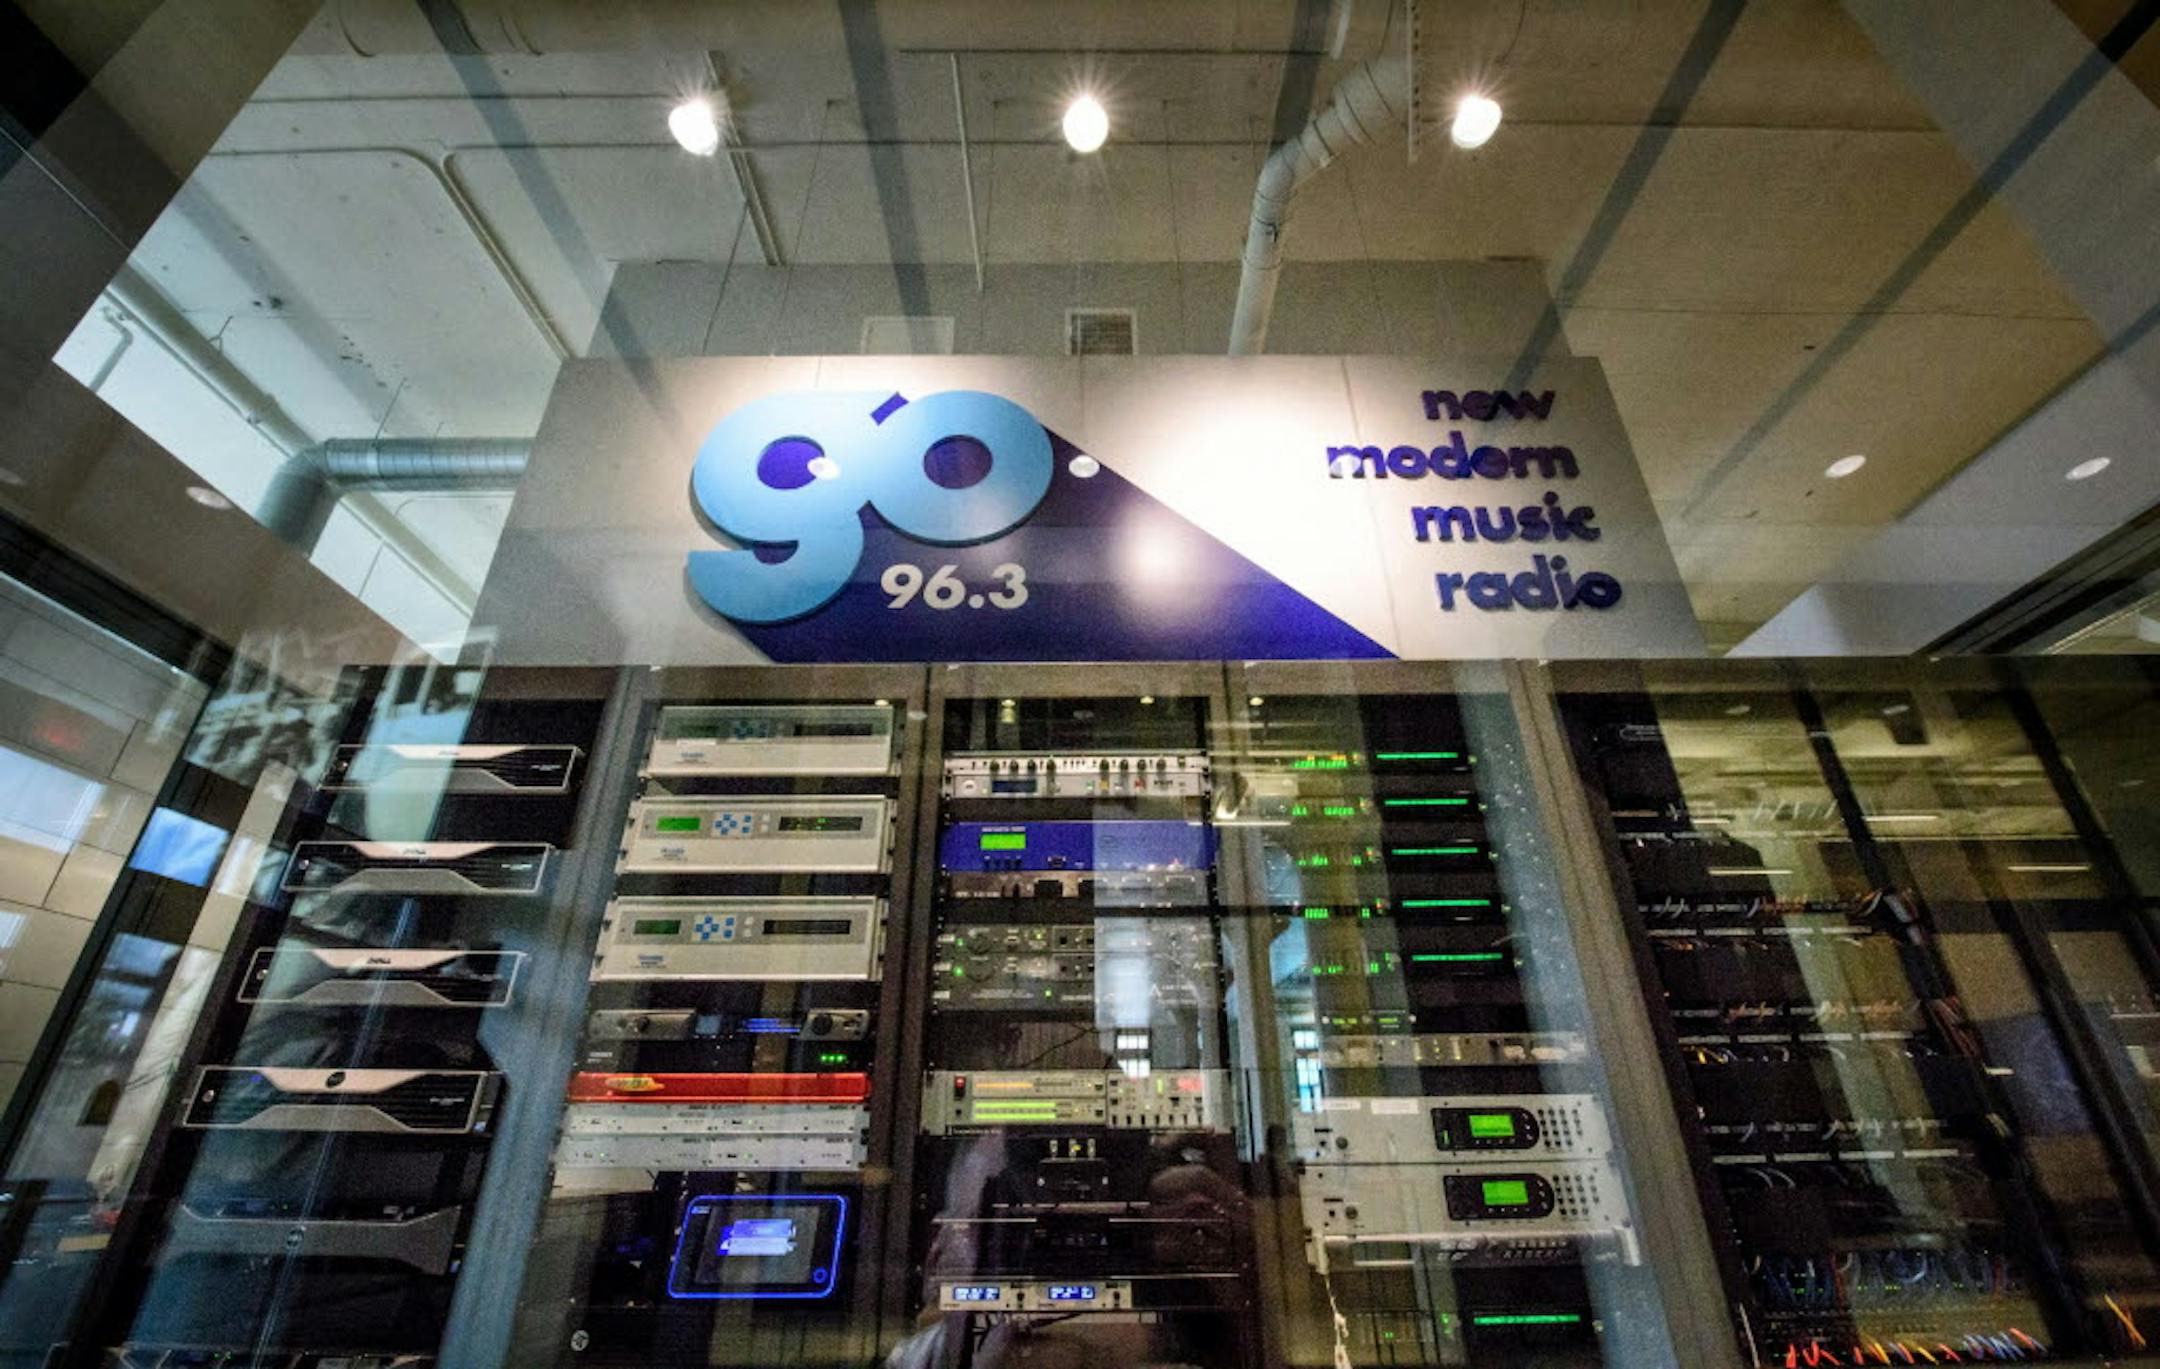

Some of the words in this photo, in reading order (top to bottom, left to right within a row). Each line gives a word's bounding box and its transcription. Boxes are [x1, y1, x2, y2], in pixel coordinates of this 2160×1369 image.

[1421, 389, 1556, 421] new
[1326, 430, 1580, 480] modern
[1411, 491, 1600, 542] music
[880, 563, 1029, 610] 96.3
[1434, 554, 1623, 612] radio
